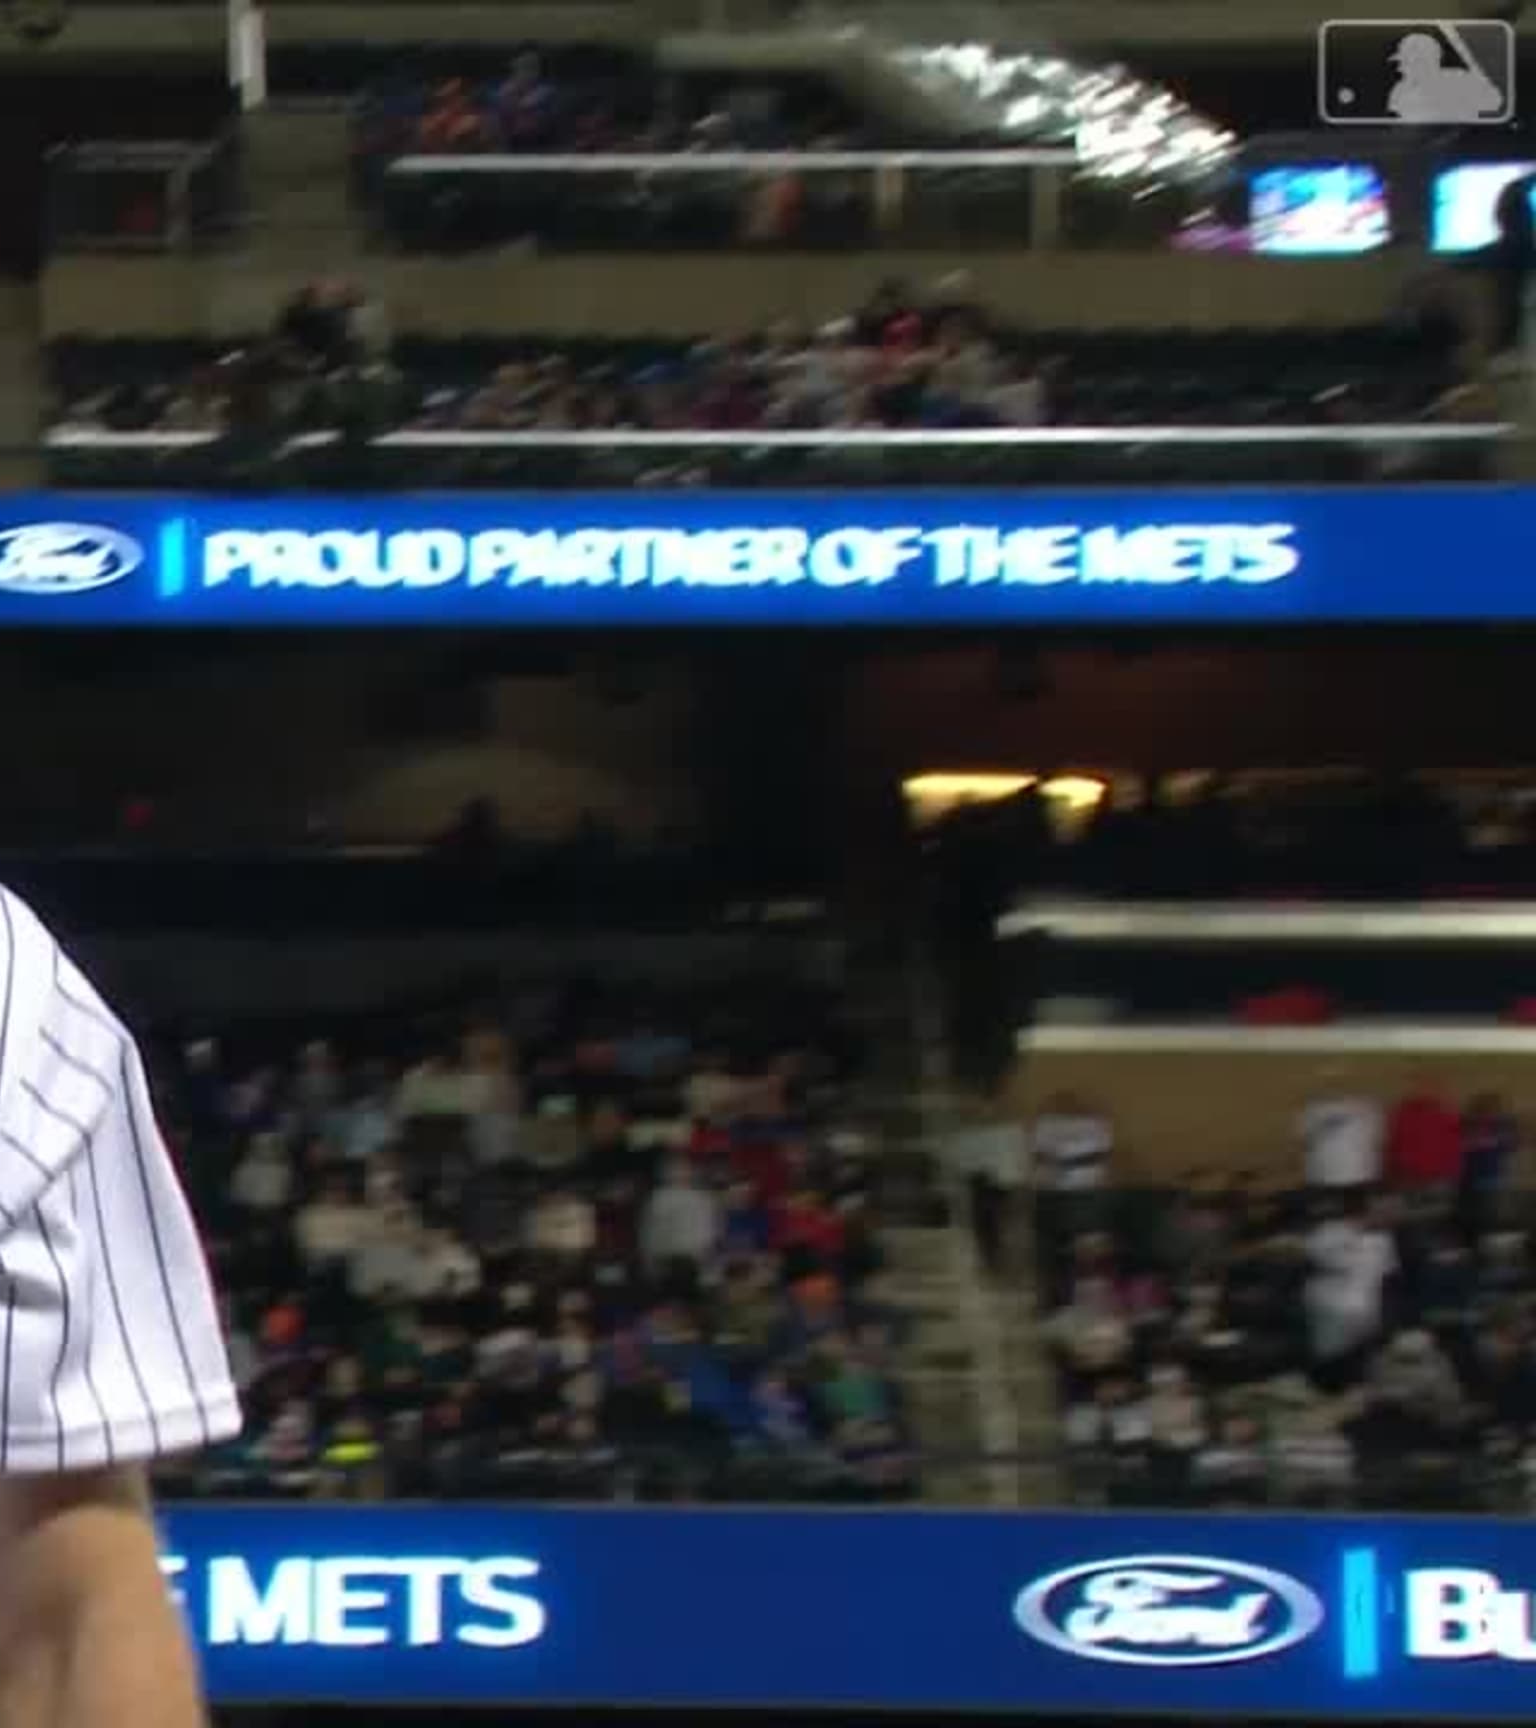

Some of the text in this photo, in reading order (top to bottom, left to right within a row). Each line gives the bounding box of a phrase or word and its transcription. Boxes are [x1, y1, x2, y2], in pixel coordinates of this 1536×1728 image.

[203, 524, 1298, 588] PROUD PARTNER OF THE METS
[208, 1556, 546, 1646] METS
